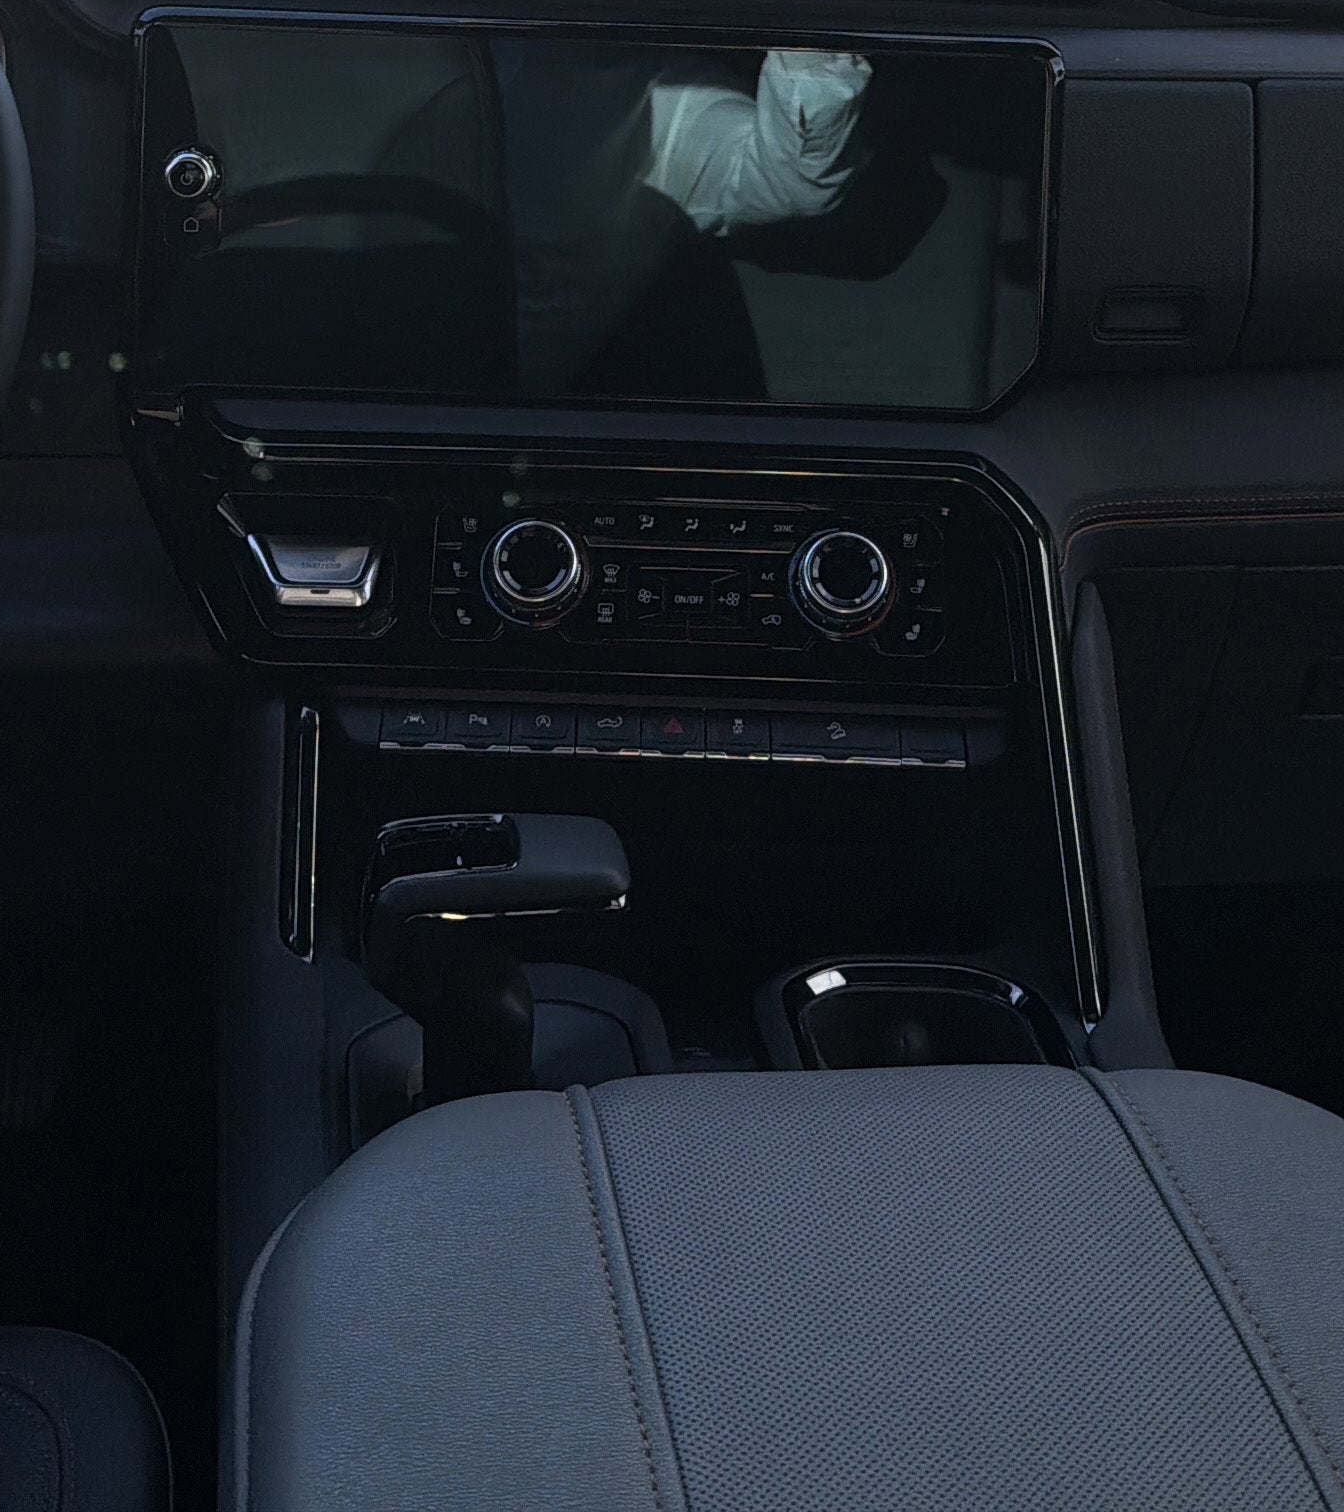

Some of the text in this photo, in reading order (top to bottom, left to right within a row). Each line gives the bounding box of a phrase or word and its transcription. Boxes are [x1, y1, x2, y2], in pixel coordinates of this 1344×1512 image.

[594, 516, 616, 525] AUTO
[773, 524, 794, 533] SYNC
[761, 572, 775, 581] A/C
[674, 595, 704, 605] ON/OFF
